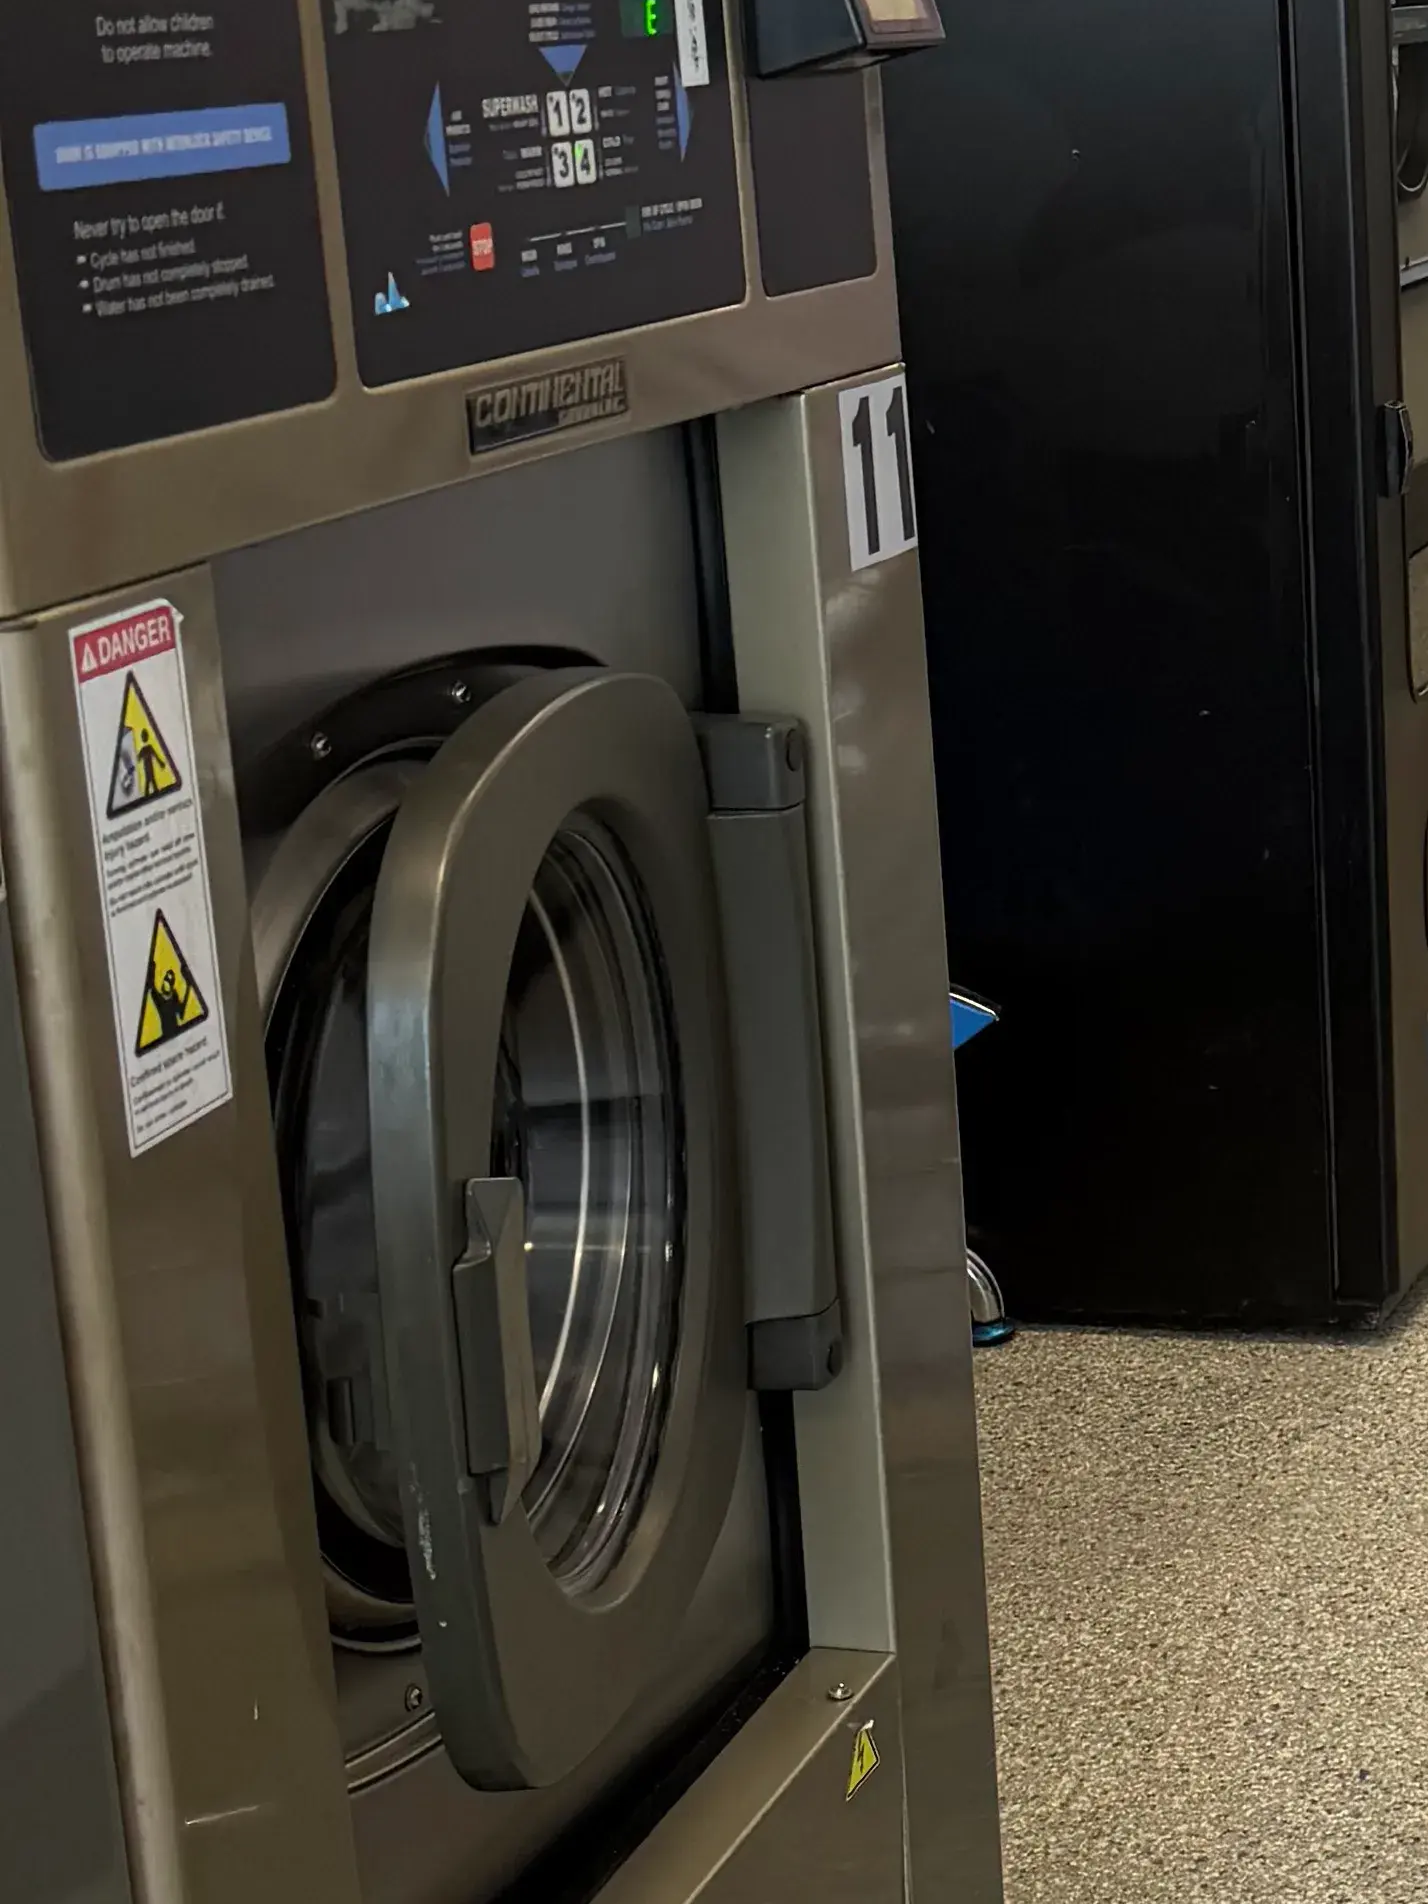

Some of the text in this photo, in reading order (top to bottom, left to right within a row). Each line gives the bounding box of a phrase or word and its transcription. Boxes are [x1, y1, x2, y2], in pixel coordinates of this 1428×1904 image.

[95, 12, 214, 37] Do not allow children
[100, 44, 115, 64] to
[116, 41, 162, 65] operate
[481, 94, 539, 118] SUPERWASH
[575, 96, 587, 126] 2
[557, 147, 570, 178] 3
[579, 144, 591, 177] 4
[73, 218, 111, 241] Never
[111, 217, 126, 240] try
[140, 211, 169, 235] open
[170, 207, 189, 227] the
[190, 203, 215, 226] door
[475, 360, 624, 428] CONTINENTAL
[851, 386, 916, 557] 11
[97, 614, 172, 666] DANGER
